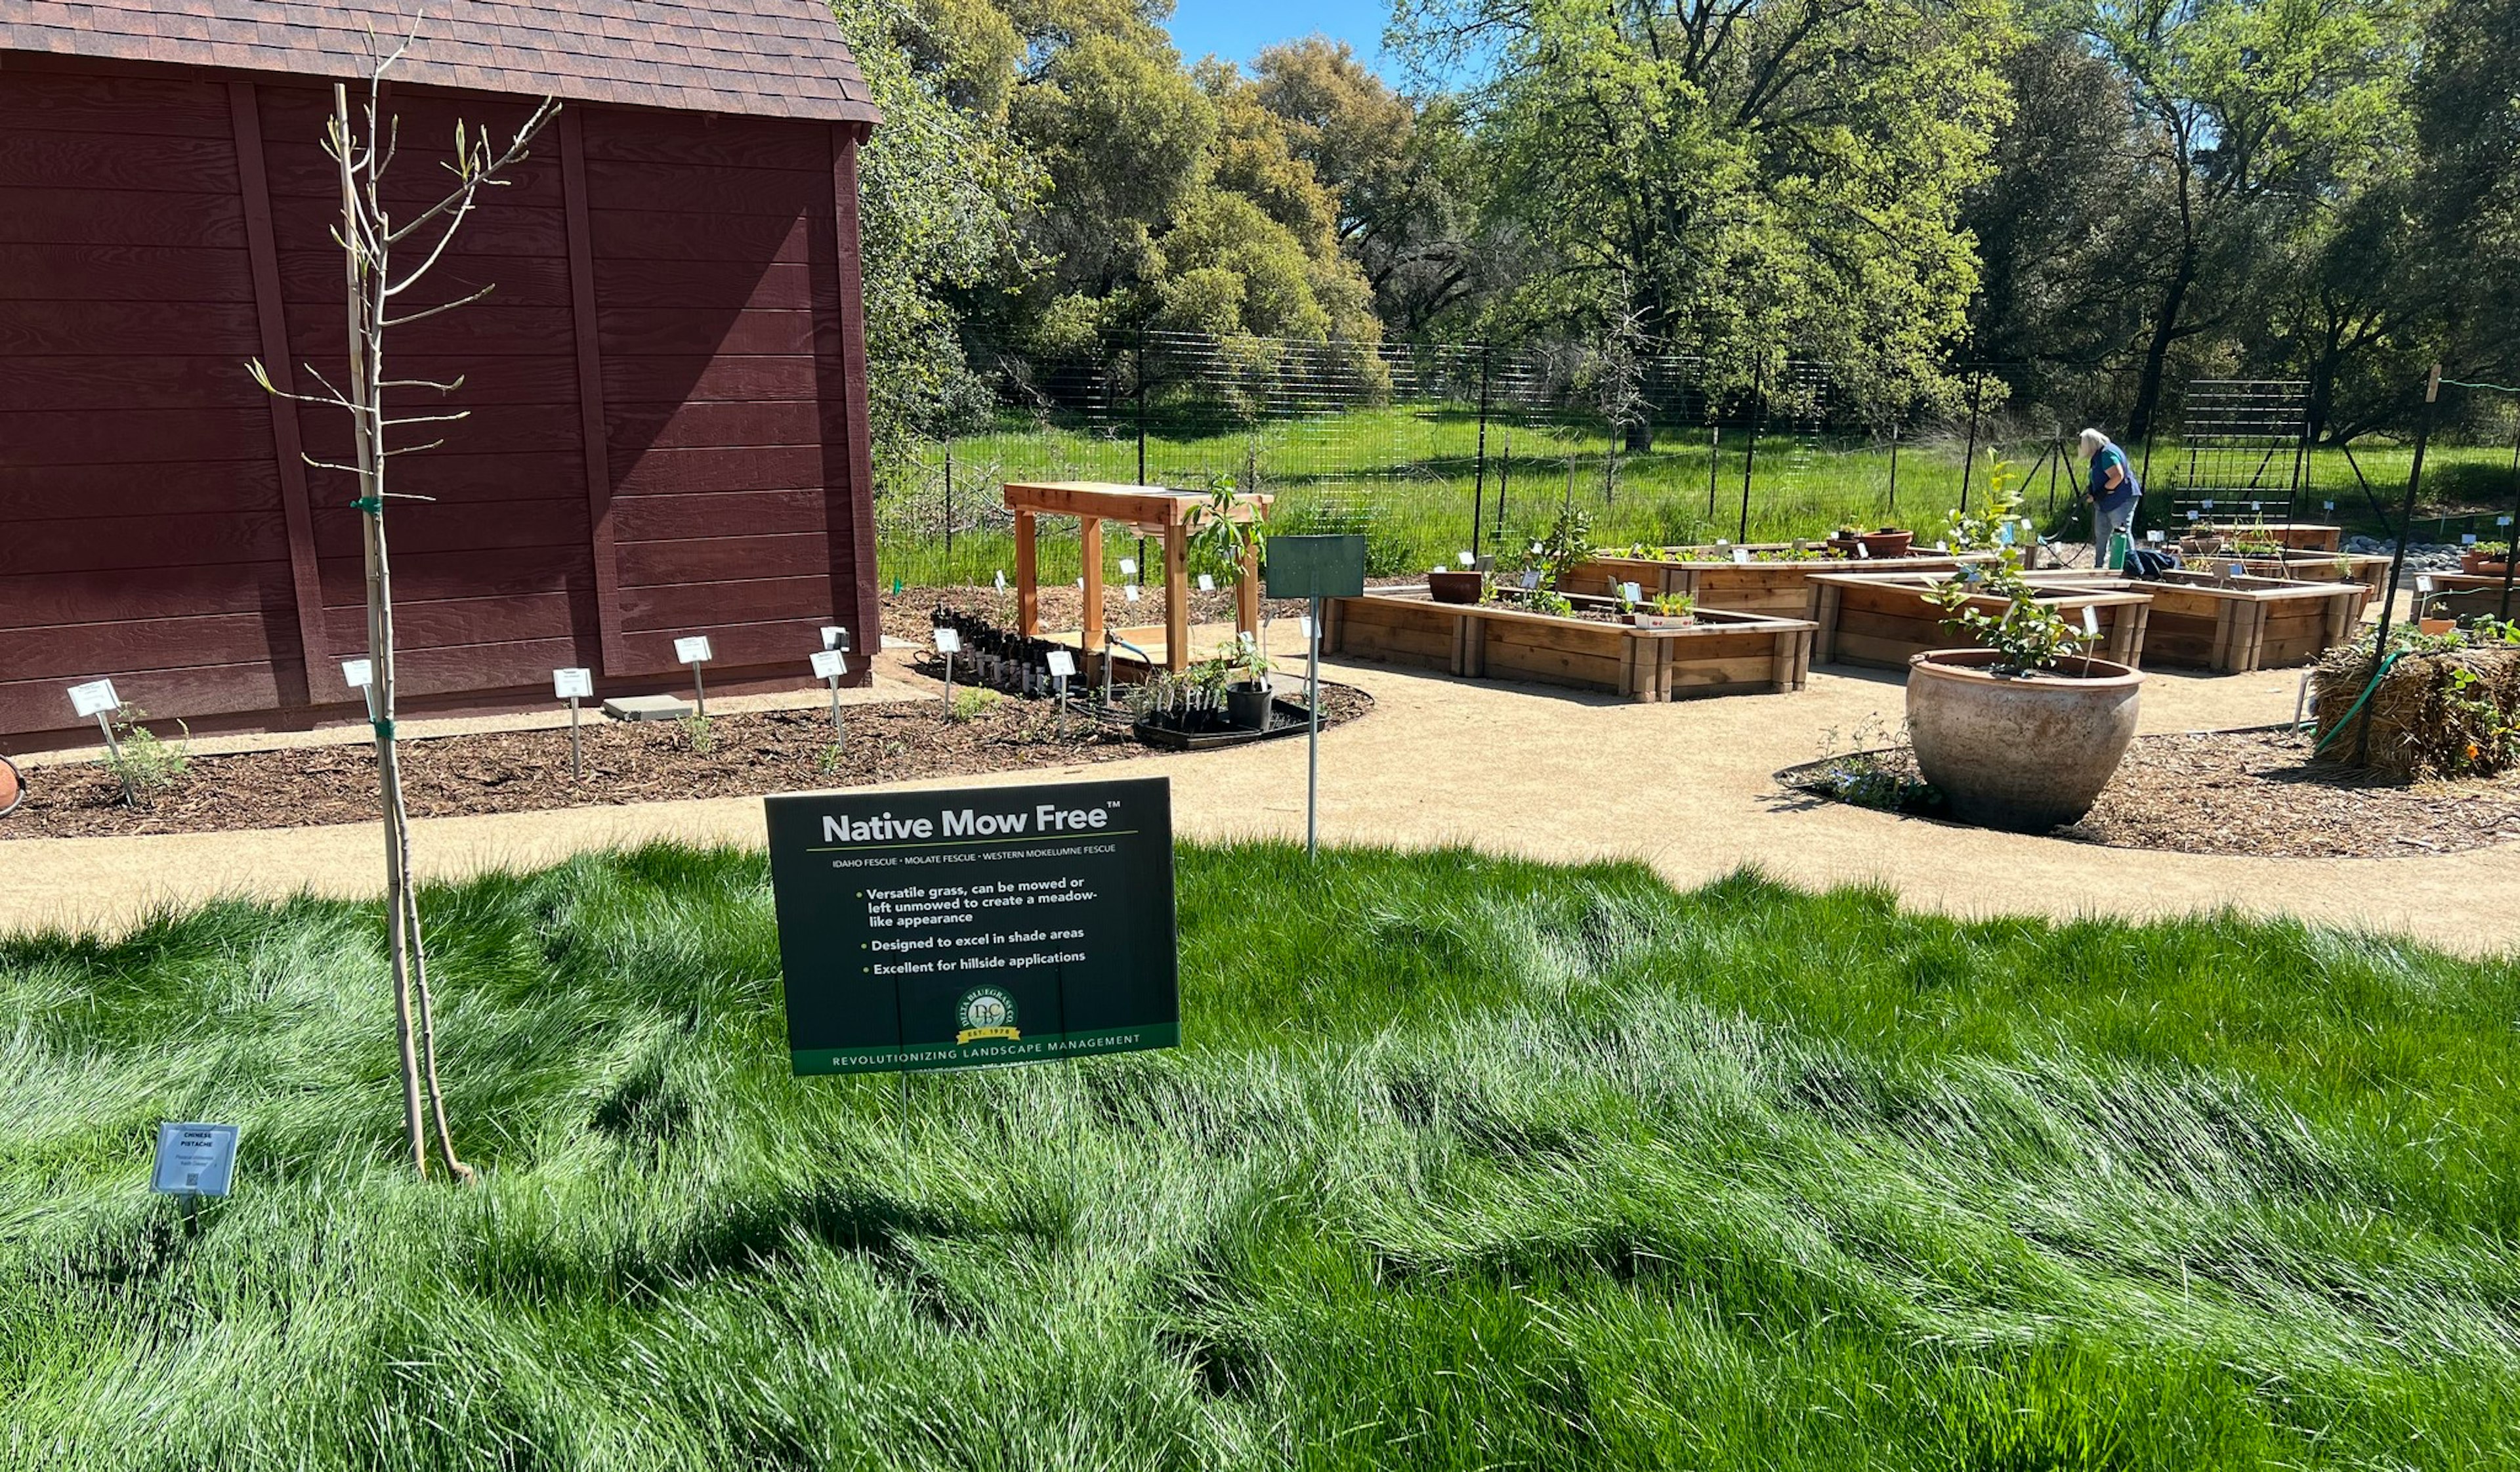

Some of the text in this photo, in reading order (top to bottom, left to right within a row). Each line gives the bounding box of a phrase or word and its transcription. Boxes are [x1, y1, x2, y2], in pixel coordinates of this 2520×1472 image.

[822, 811, 933, 842] Native
[941, 809, 1028, 837] Mow
[832, 843, 1116, 868] IDAHO FESCUE MOLATE FESCUE WESTERN MOKELUMNE FESCUE
[866, 877, 1085, 900] Versatile grass, can be mowed or
[868, 890, 1097, 914] left unmowed to create a meadow-
[870, 914, 973, 929] like appearance
[872, 929, 1085, 952] Designed to excel in shade areas
[873, 951, 1086, 975] Excellent for hillside applications
[960, 1002, 971, 1028] DELTA
[967, 988, 1014, 1009] BLUEGRASS
[832, 1034, 1141, 1066] REVOLUTIONIZING LANDSCAPE MANAGEMENT
